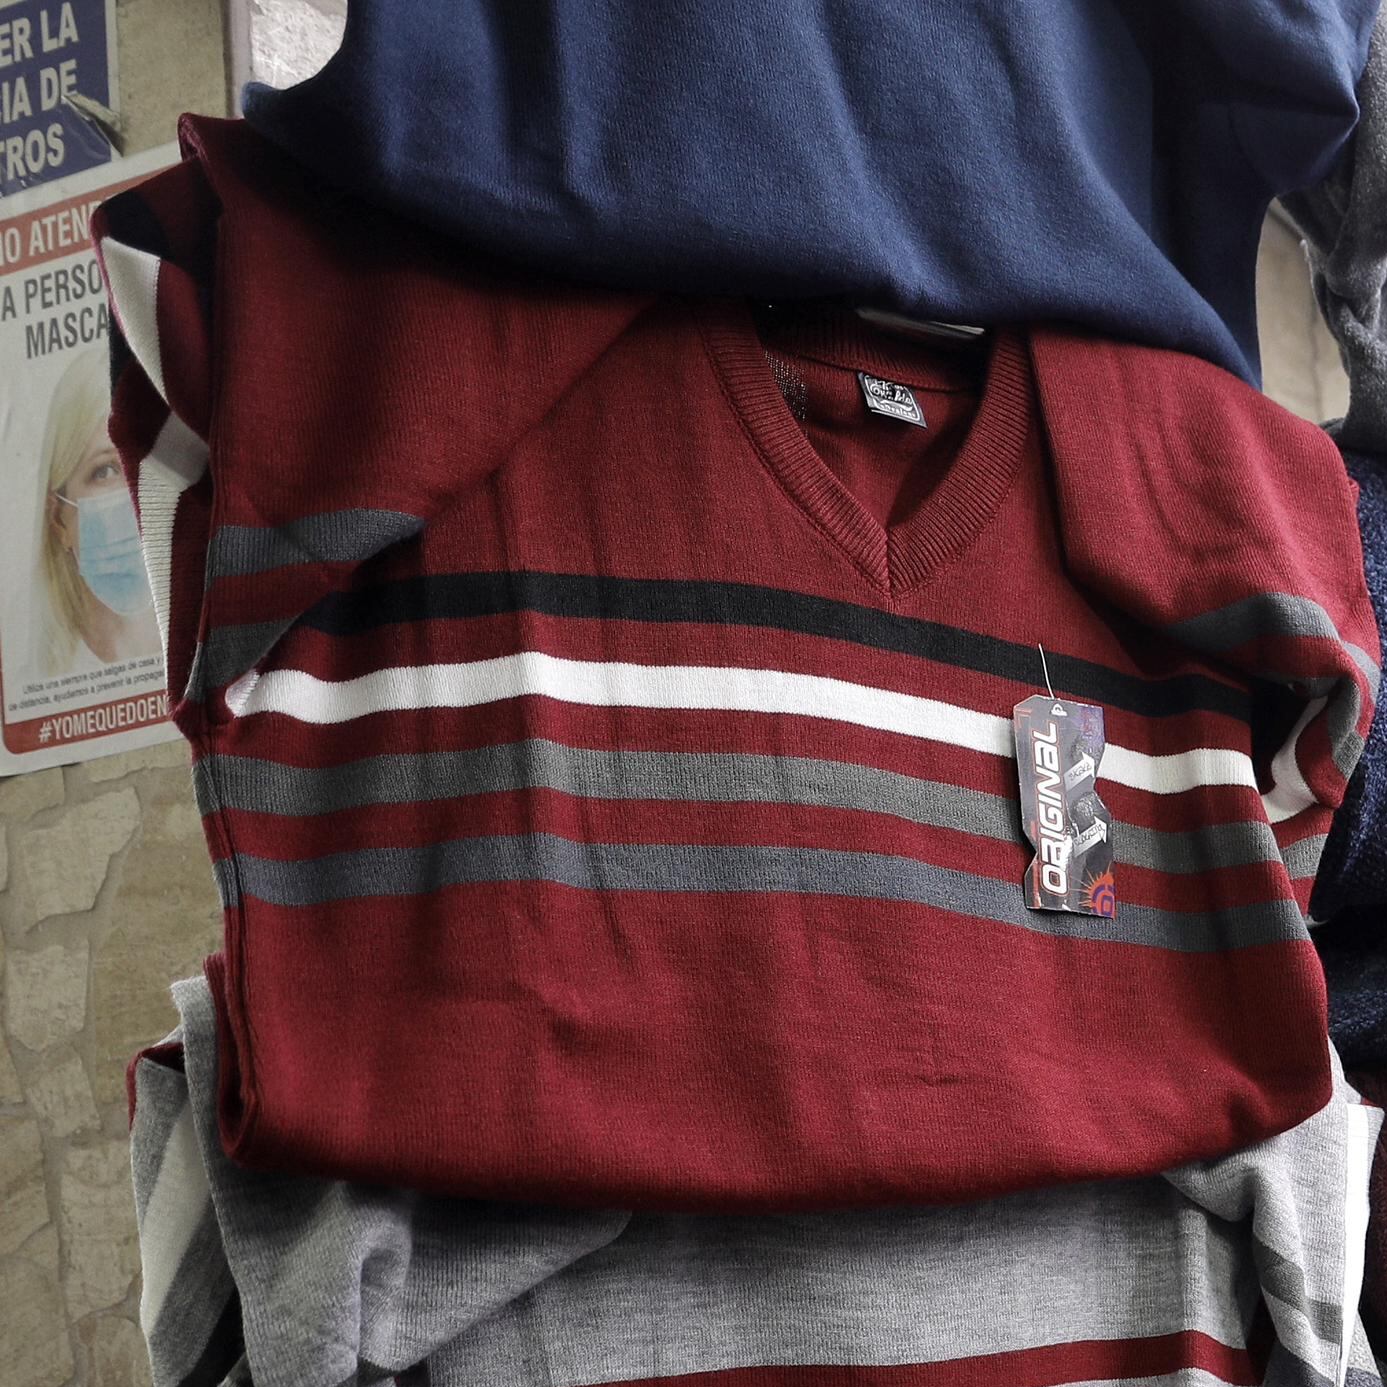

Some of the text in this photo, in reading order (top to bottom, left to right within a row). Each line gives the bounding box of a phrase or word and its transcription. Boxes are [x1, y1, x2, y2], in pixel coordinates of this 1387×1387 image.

[40, 2, 79, 52] LA
[0, 59, 77, 124] IA DE
[0, 227, 21, 267] O
[2, 285, 17, 322] A
[1032, 721, 1070, 895] ORIGINAL
